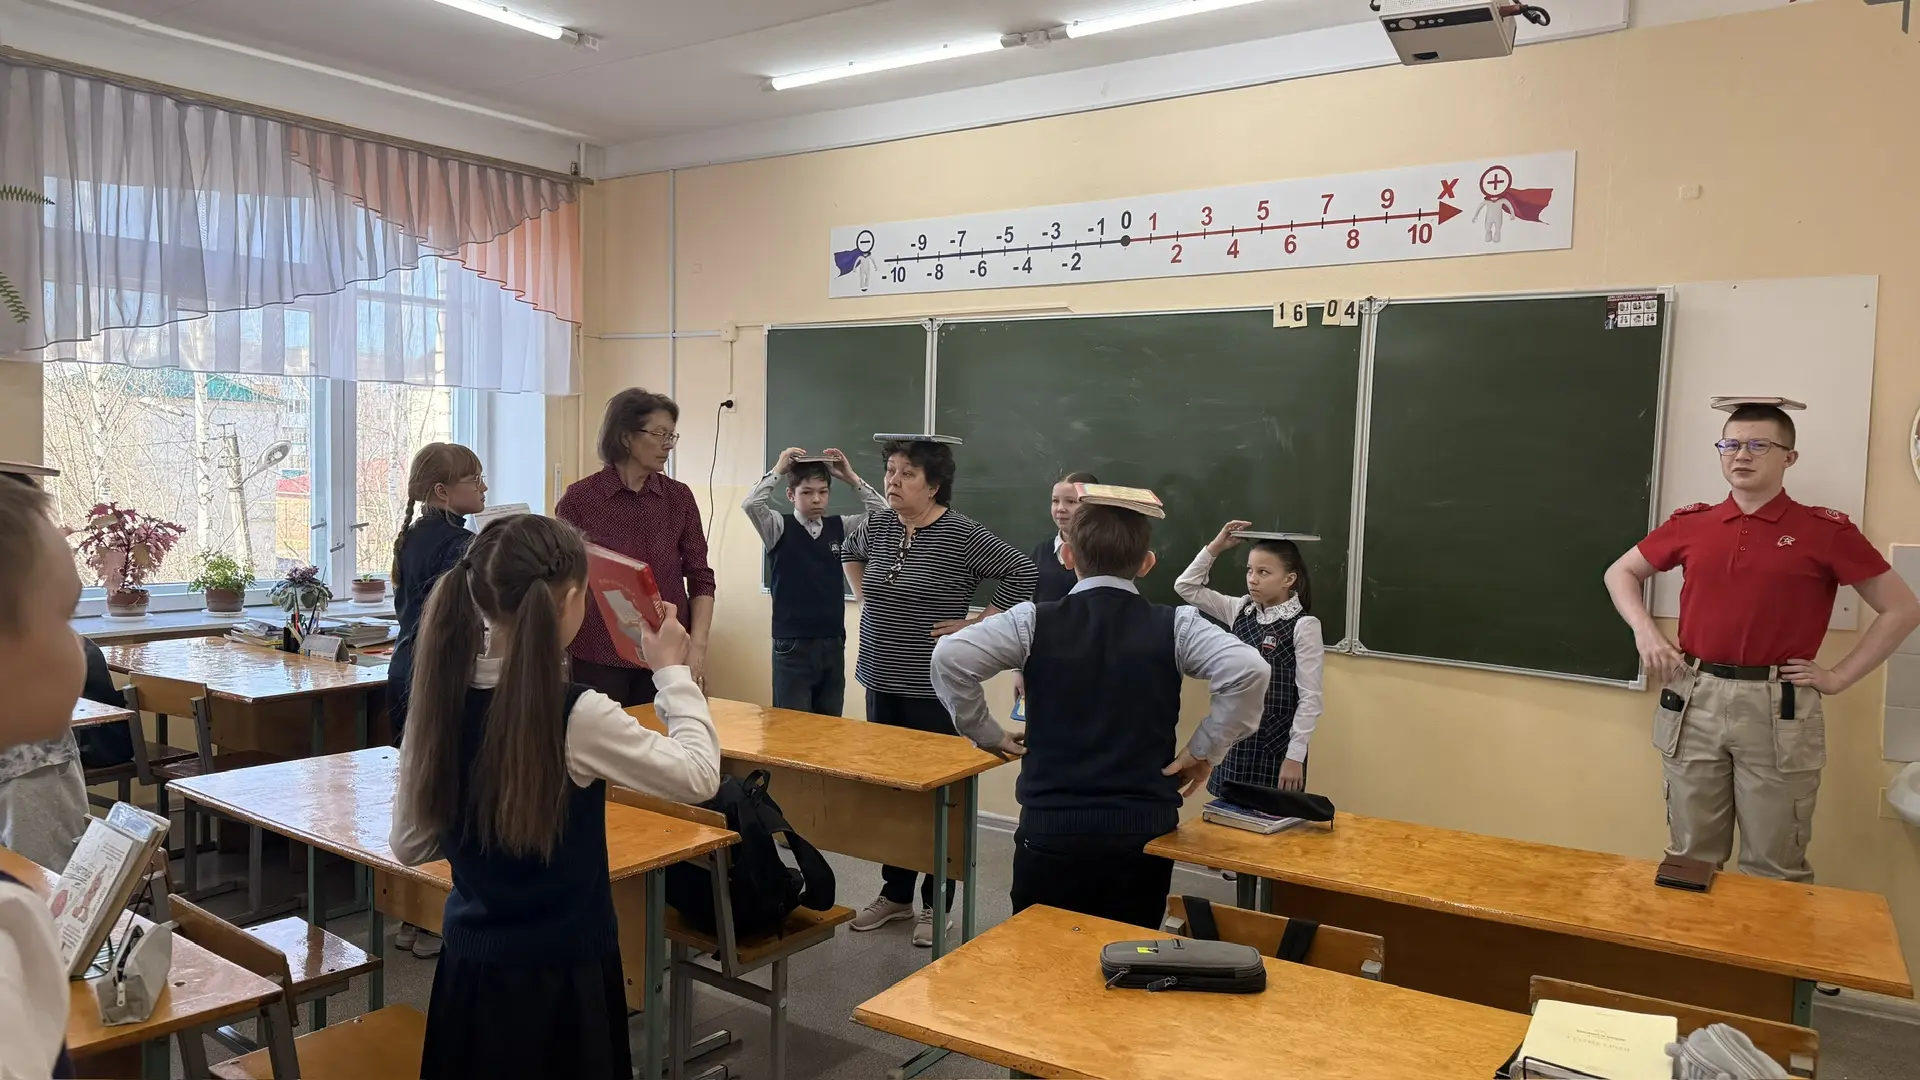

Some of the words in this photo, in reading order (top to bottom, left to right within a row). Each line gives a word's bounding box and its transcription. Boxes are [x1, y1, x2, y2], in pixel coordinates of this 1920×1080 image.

[911, 234, 927, 250] -9
[950, 230, 967, 248] -7
[996, 226, 1014, 244] -5
[1042, 222, 1061, 240] -3
[1088, 217, 1105, 235] -1
[1121, 210, 1132, 229] 0
[1148, 212, 1158, 231] 1
[1201, 206, 1213, 227] 3
[1257, 200, 1270, 221] 5
[1321, 193, 1334, 215] 7
[1380, 188, 1394, 209] 9
[881, 266, 906, 284] -10
[926, 263, 944, 281] -8
[969, 260, 987, 278] -6
[1013, 256, 1032, 275] -4
[1061, 252, 1081, 272] -2
[1170, 244, 1183, 264] 2
[1226, 238, 1240, 259] 4
[1284, 234, 1297, 255] 6
[1346, 229, 1360, 250] 8
[1407, 223, 1433, 245] 10
